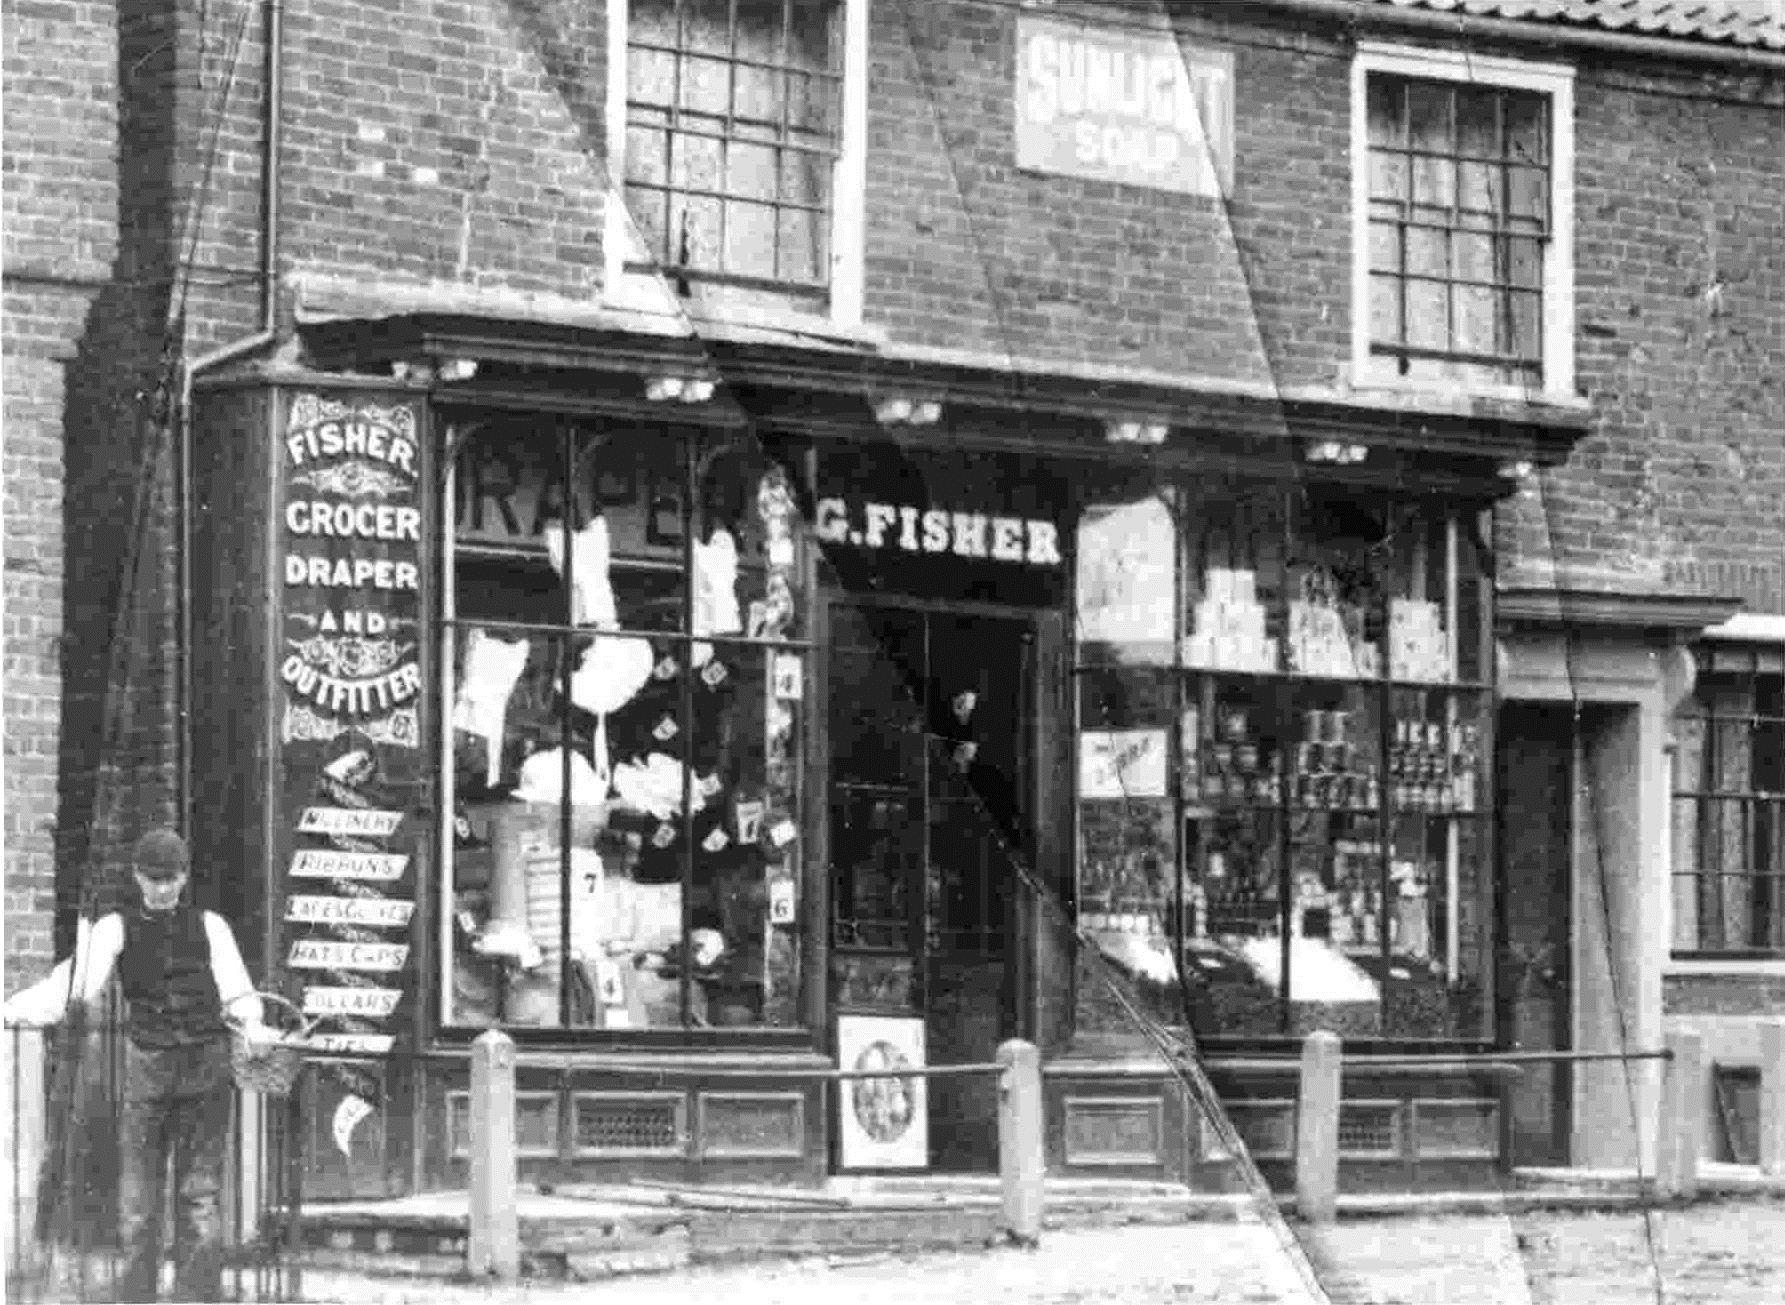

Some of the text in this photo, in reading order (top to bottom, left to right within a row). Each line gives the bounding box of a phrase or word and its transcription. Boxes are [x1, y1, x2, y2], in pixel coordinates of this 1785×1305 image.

[1027, 34, 1226, 153] SUNLIGT
[285, 554, 419, 589] DRAPER
[320, 609, 386, 633] AND
[281, 654, 421, 713] OUTFITTER
[309, 993, 393, 1012] OLLARS
